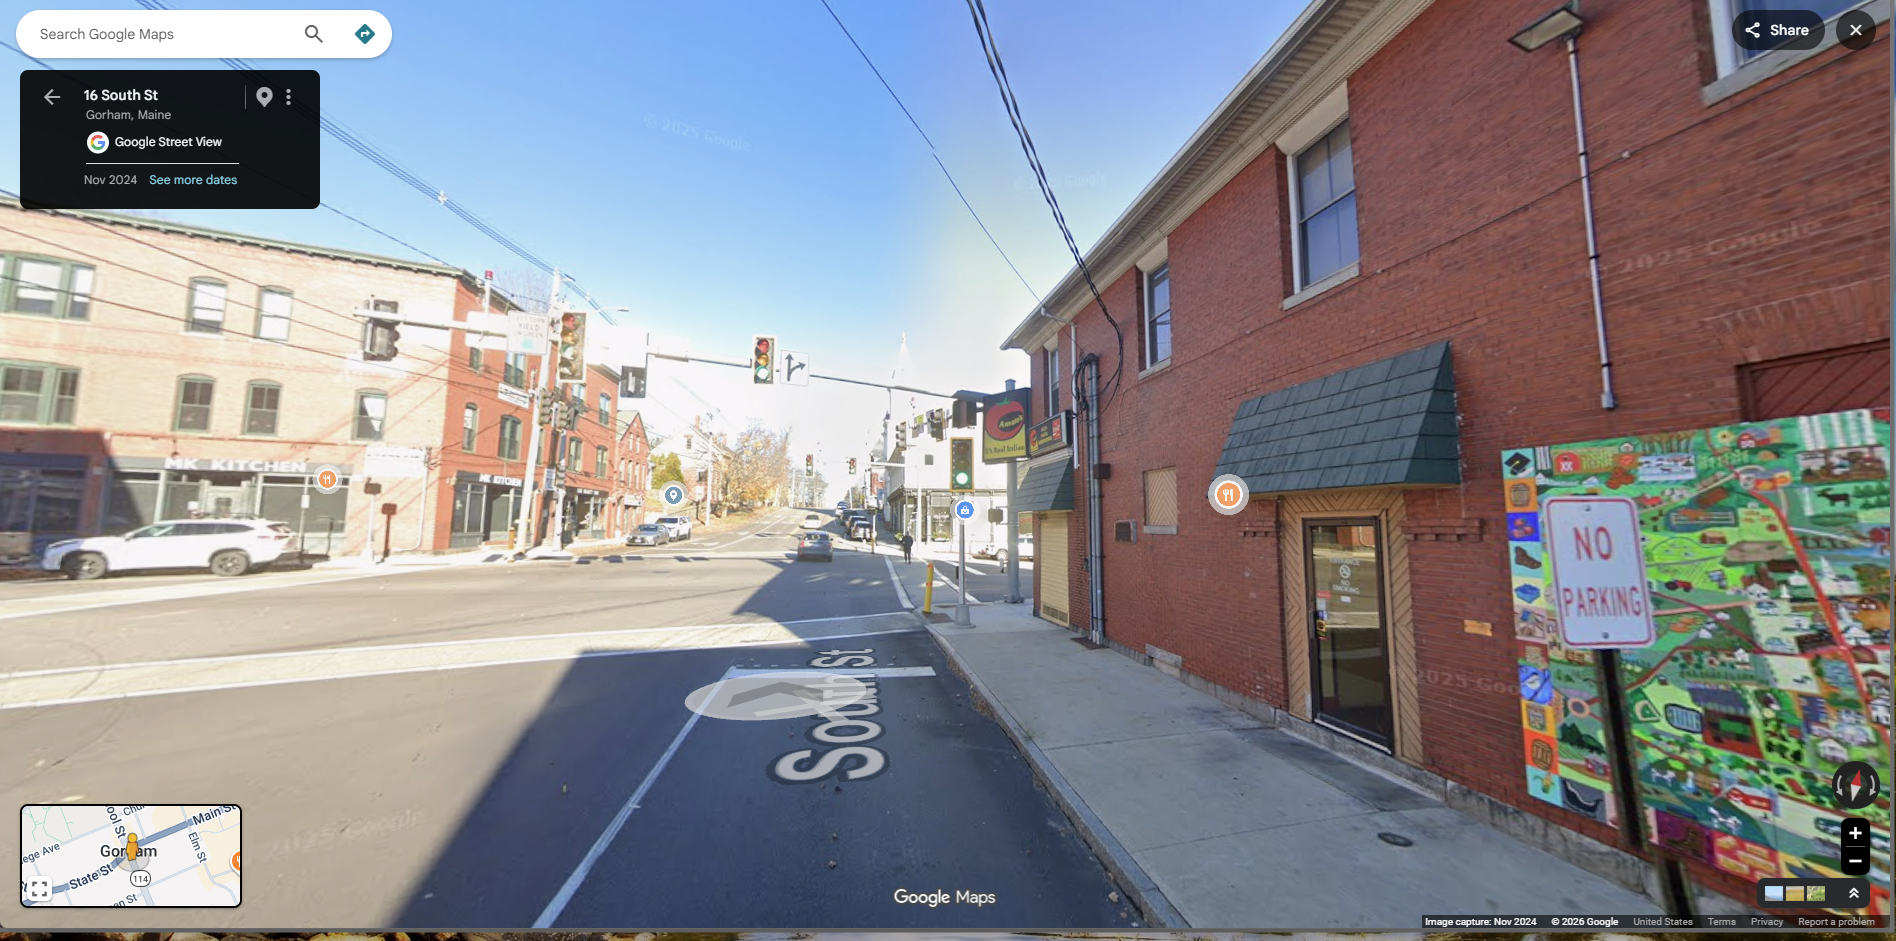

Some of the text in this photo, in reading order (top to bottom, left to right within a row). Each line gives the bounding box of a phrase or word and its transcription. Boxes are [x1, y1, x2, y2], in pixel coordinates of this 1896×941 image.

[518, 322, 540, 332] YIELD
[164, 458, 307, 473] MK KITCHEN
[1573, 526, 1613, 561] NO
[1562, 586, 1642, 618] PARKING
